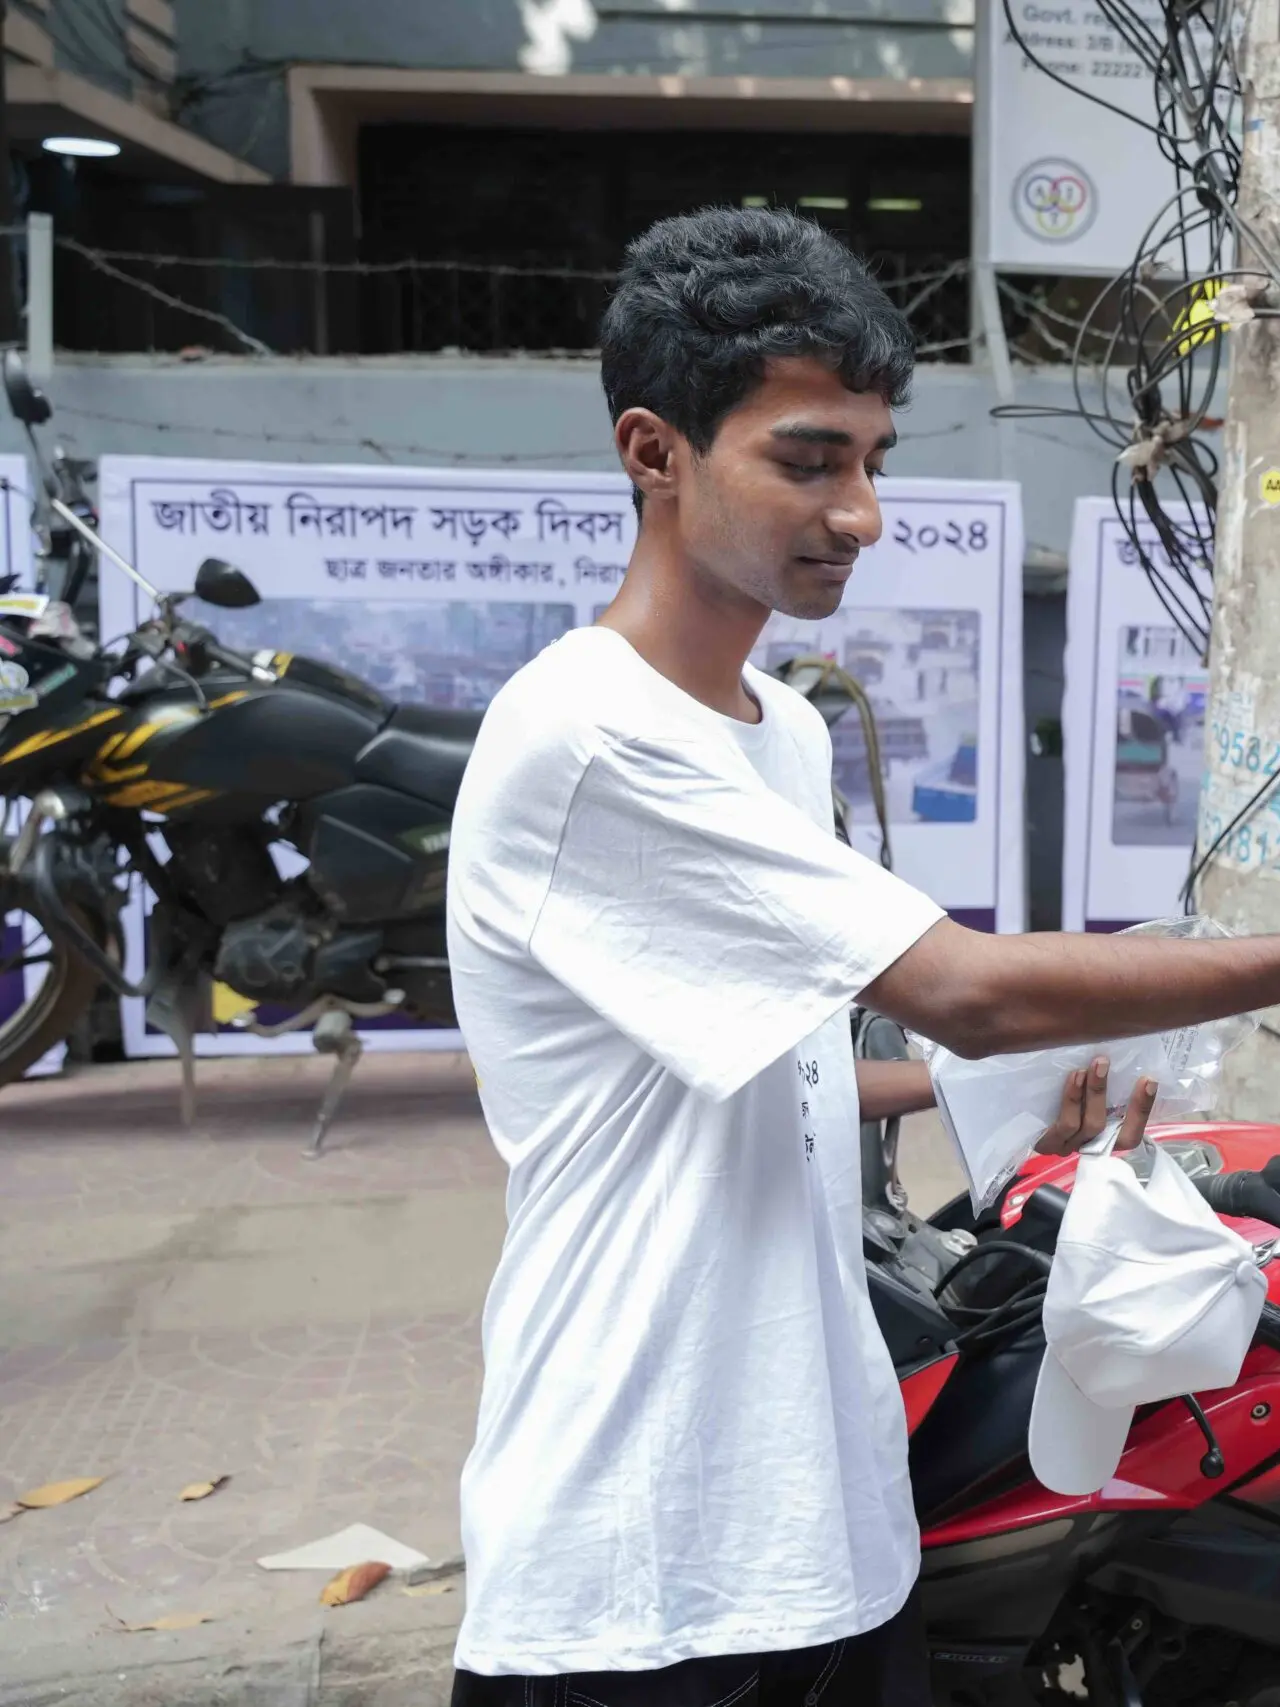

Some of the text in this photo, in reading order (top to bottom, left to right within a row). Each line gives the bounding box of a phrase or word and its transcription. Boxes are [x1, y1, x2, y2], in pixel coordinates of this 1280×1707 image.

[150, 489, 627, 547] জাতীয় নিরাপদ সড়ক দিবস
[892, 519, 989, 555] ২০২৪
[376, 558, 457, 582] জনতার
